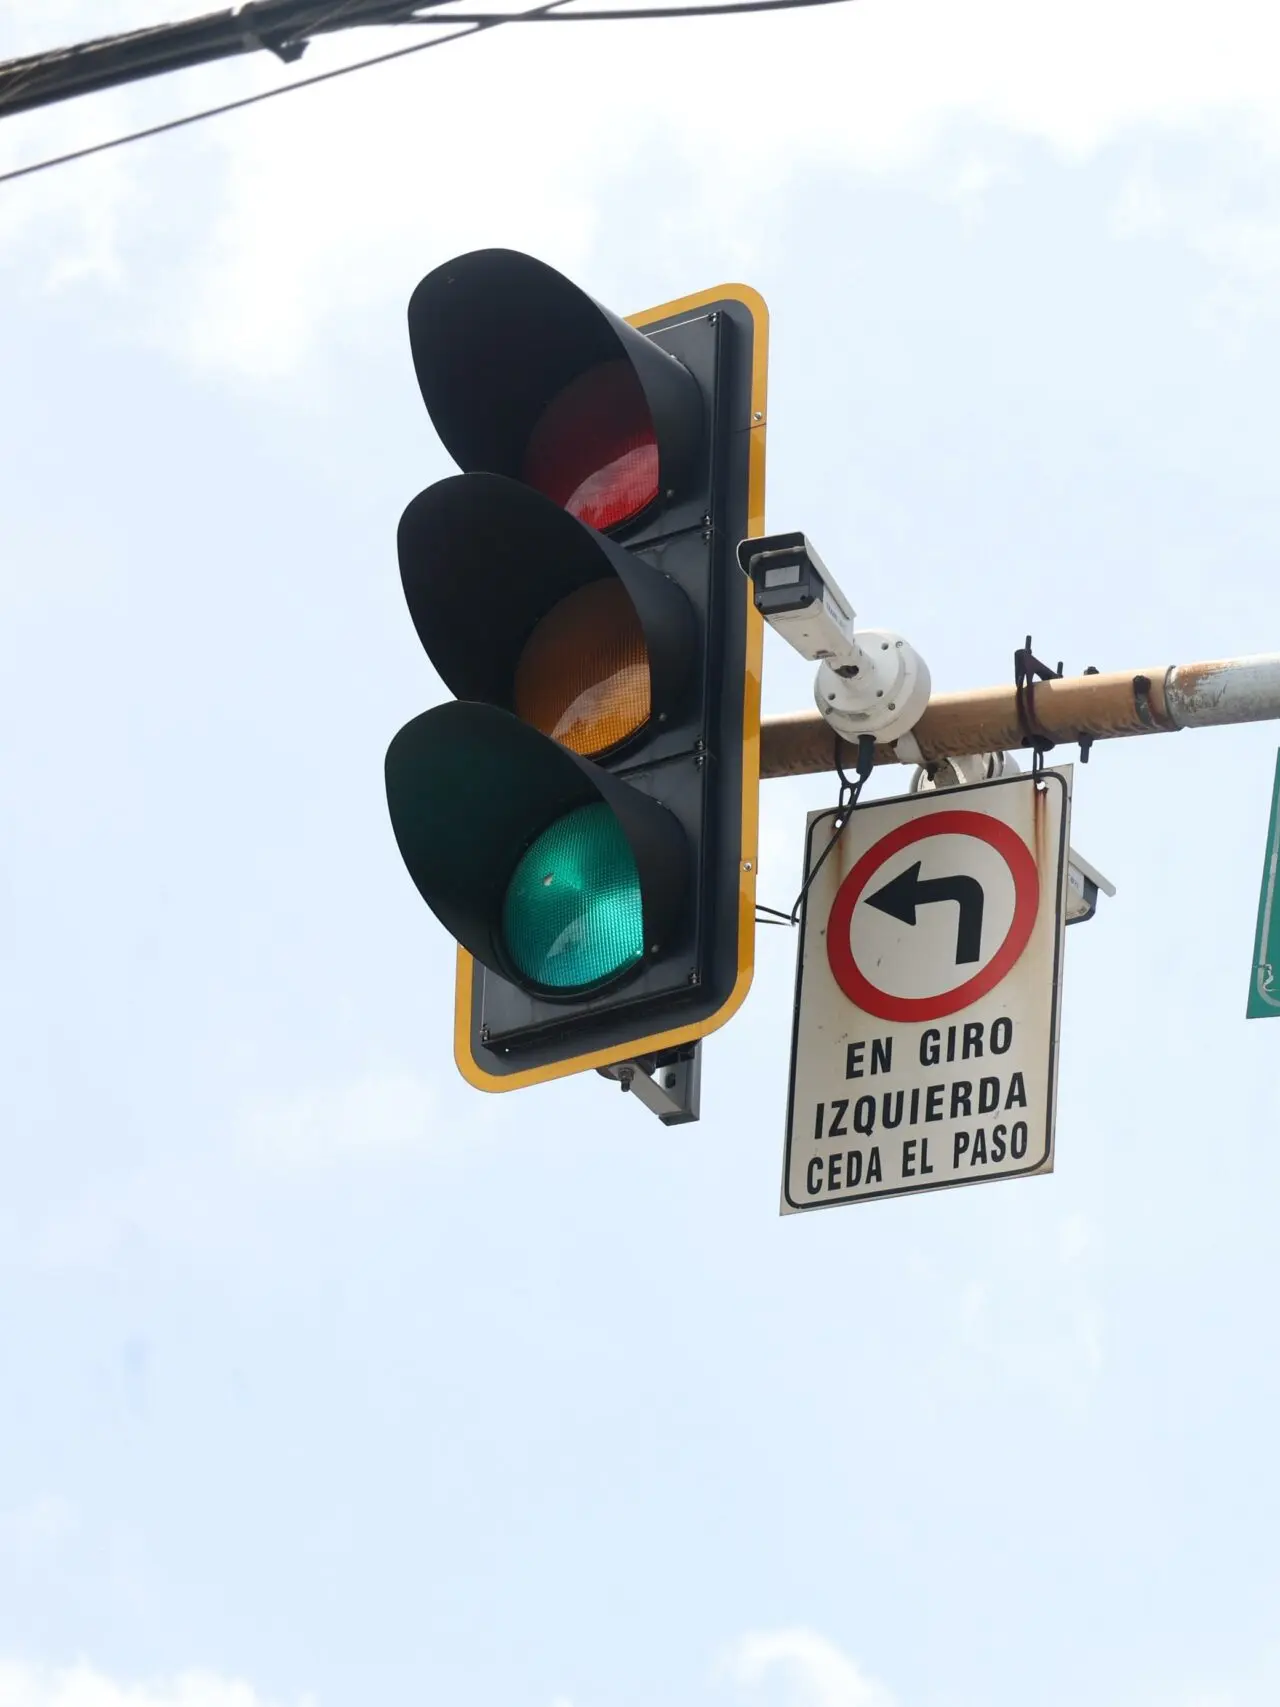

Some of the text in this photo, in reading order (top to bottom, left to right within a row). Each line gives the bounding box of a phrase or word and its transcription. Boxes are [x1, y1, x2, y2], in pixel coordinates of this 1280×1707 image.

[845, 1016, 1013, 1080] EN GIRO
[813, 1071, 1027, 1140] IZQUIERDA
[806, 1121, 1028, 1195] CEDA EL PASO
